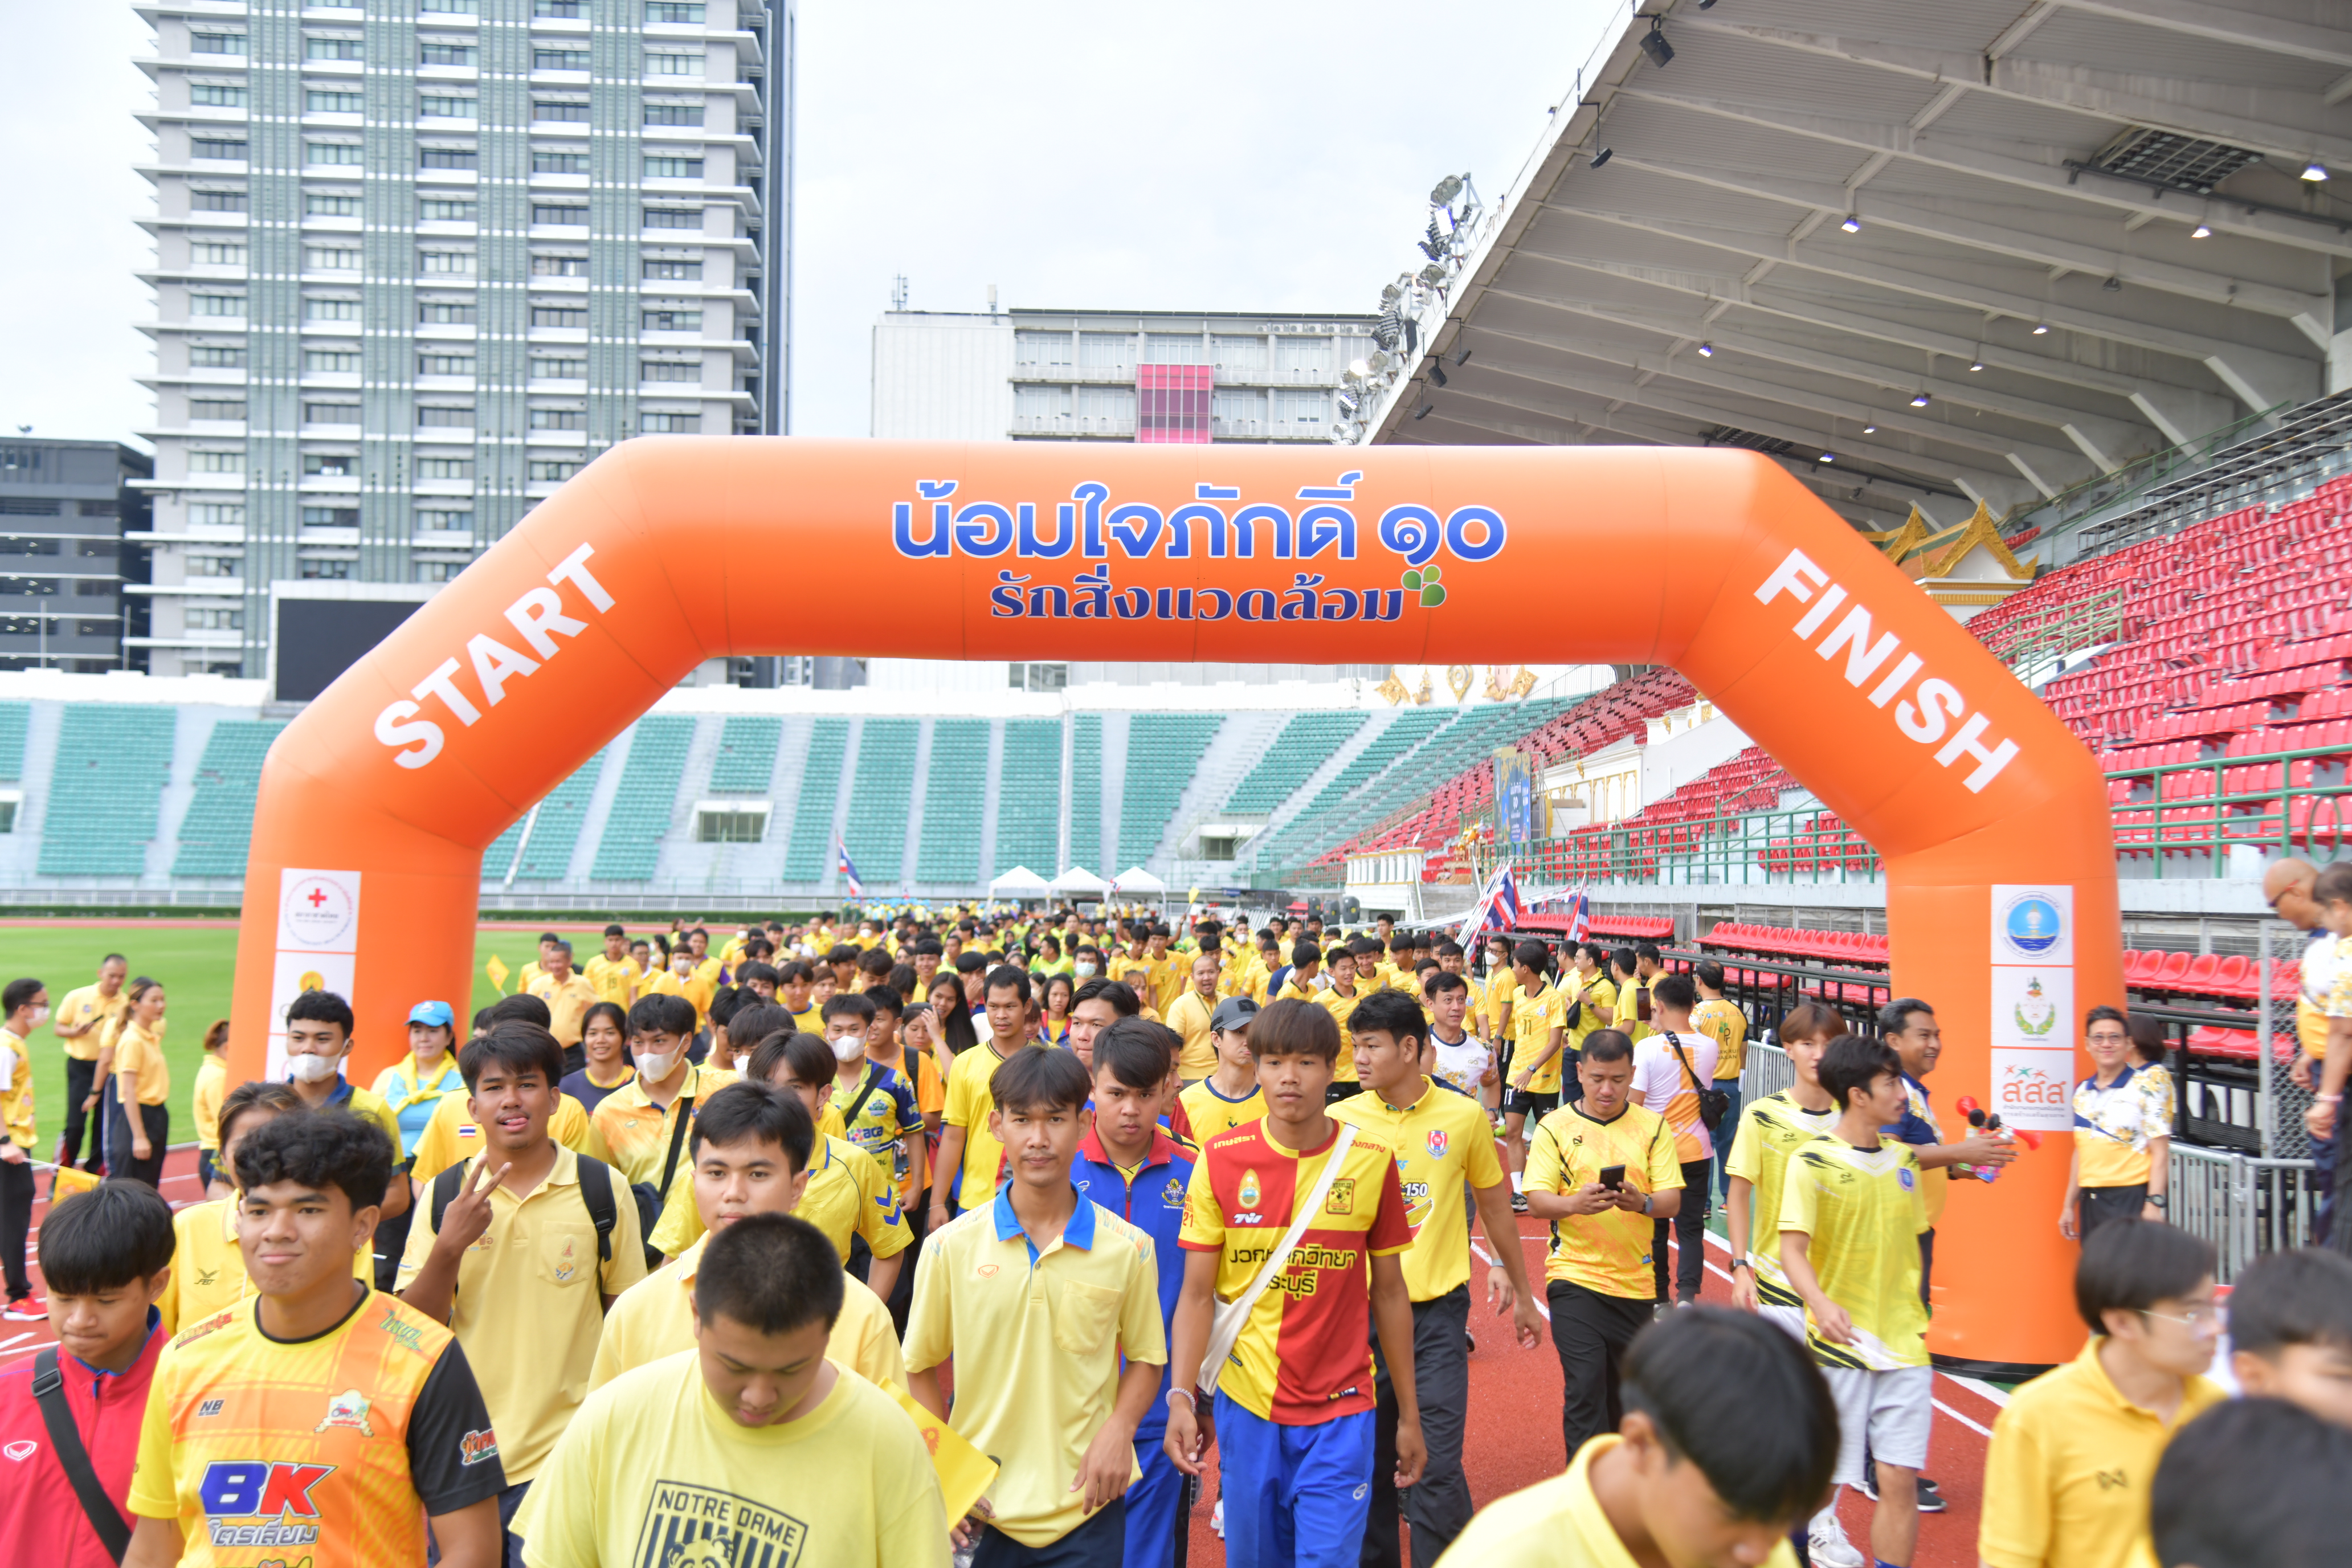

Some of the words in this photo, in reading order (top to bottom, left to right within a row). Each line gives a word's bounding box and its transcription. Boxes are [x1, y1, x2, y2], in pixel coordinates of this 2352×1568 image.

[892, 469, 1363, 560] น้อมใจภักดิ์
[1377, 503, 1507, 567] ๑๐
[990, 562, 1404, 622] รักสิ่งแวดล้อม
[374, 541, 616, 769] START
[1753, 548, 2021, 794] FINISH
[2002, 1079, 2067, 1104] สสส
[200, 1399, 224, 1411] NB
[198, 1460, 338, 1518] BK
[657, 1489, 732, 1521] NOTRE
[737, 1506, 797, 1547] DAME
